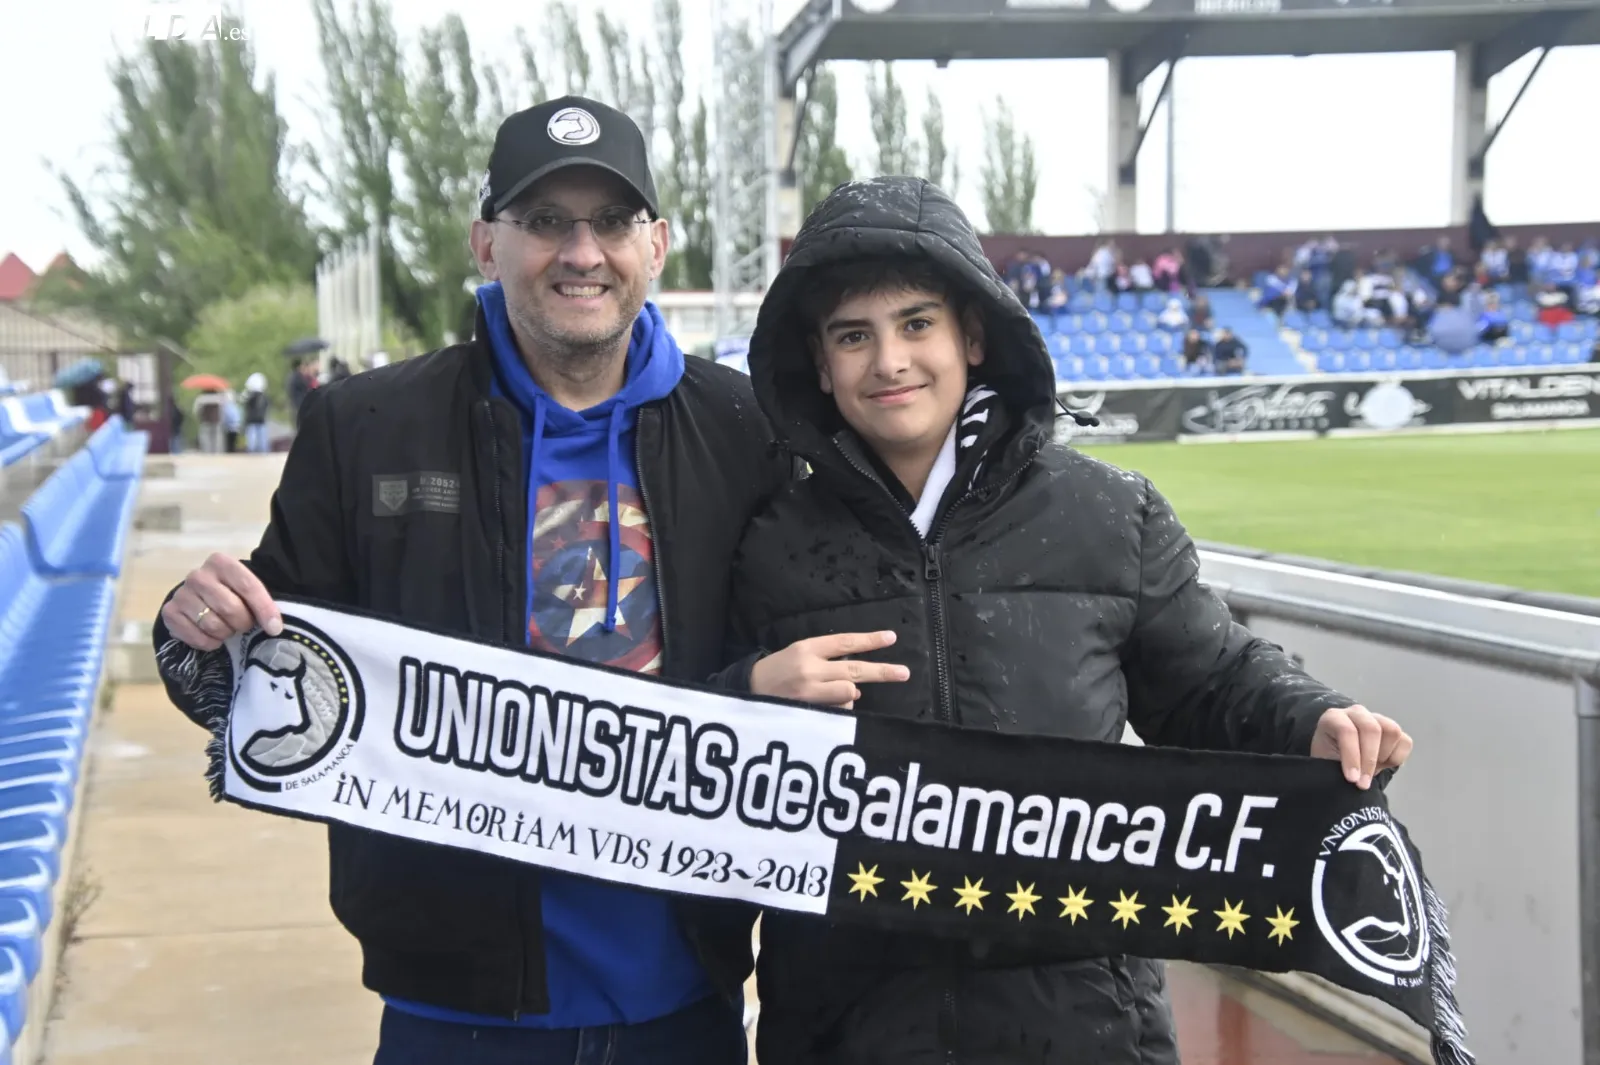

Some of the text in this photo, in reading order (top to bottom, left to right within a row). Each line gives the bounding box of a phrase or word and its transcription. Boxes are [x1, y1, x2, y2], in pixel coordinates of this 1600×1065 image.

[285, 743, 354, 791] DE SALAMANCA
[394, 656, 1279, 879] UNIONISTAS de Salamanca C.F.
[588, 828, 651, 871] VDS
